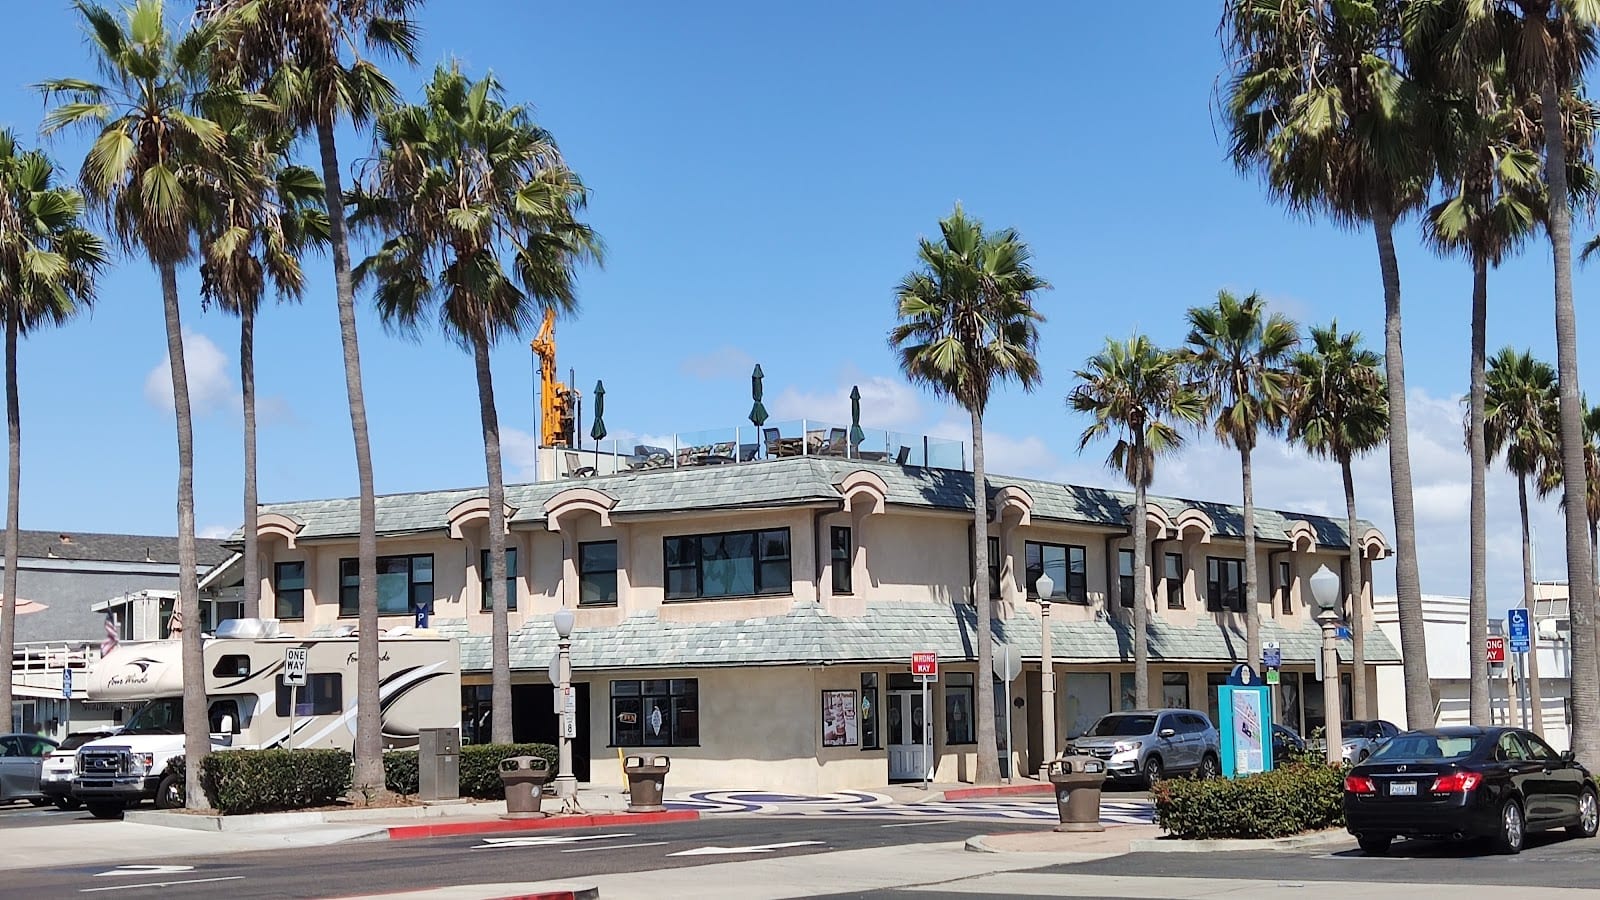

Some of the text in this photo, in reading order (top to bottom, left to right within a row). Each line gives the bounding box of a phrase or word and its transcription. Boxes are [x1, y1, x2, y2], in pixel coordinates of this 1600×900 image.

[418, 612, 425, 622] P
[1486, 640, 1503, 649] ONG
[288, 650, 305, 660] ONE
[913, 654, 935, 663] WRONG
[1486, 650, 1497, 660] AY
[287, 661, 305, 670] WAY
[917, 664, 930, 673] WAY
